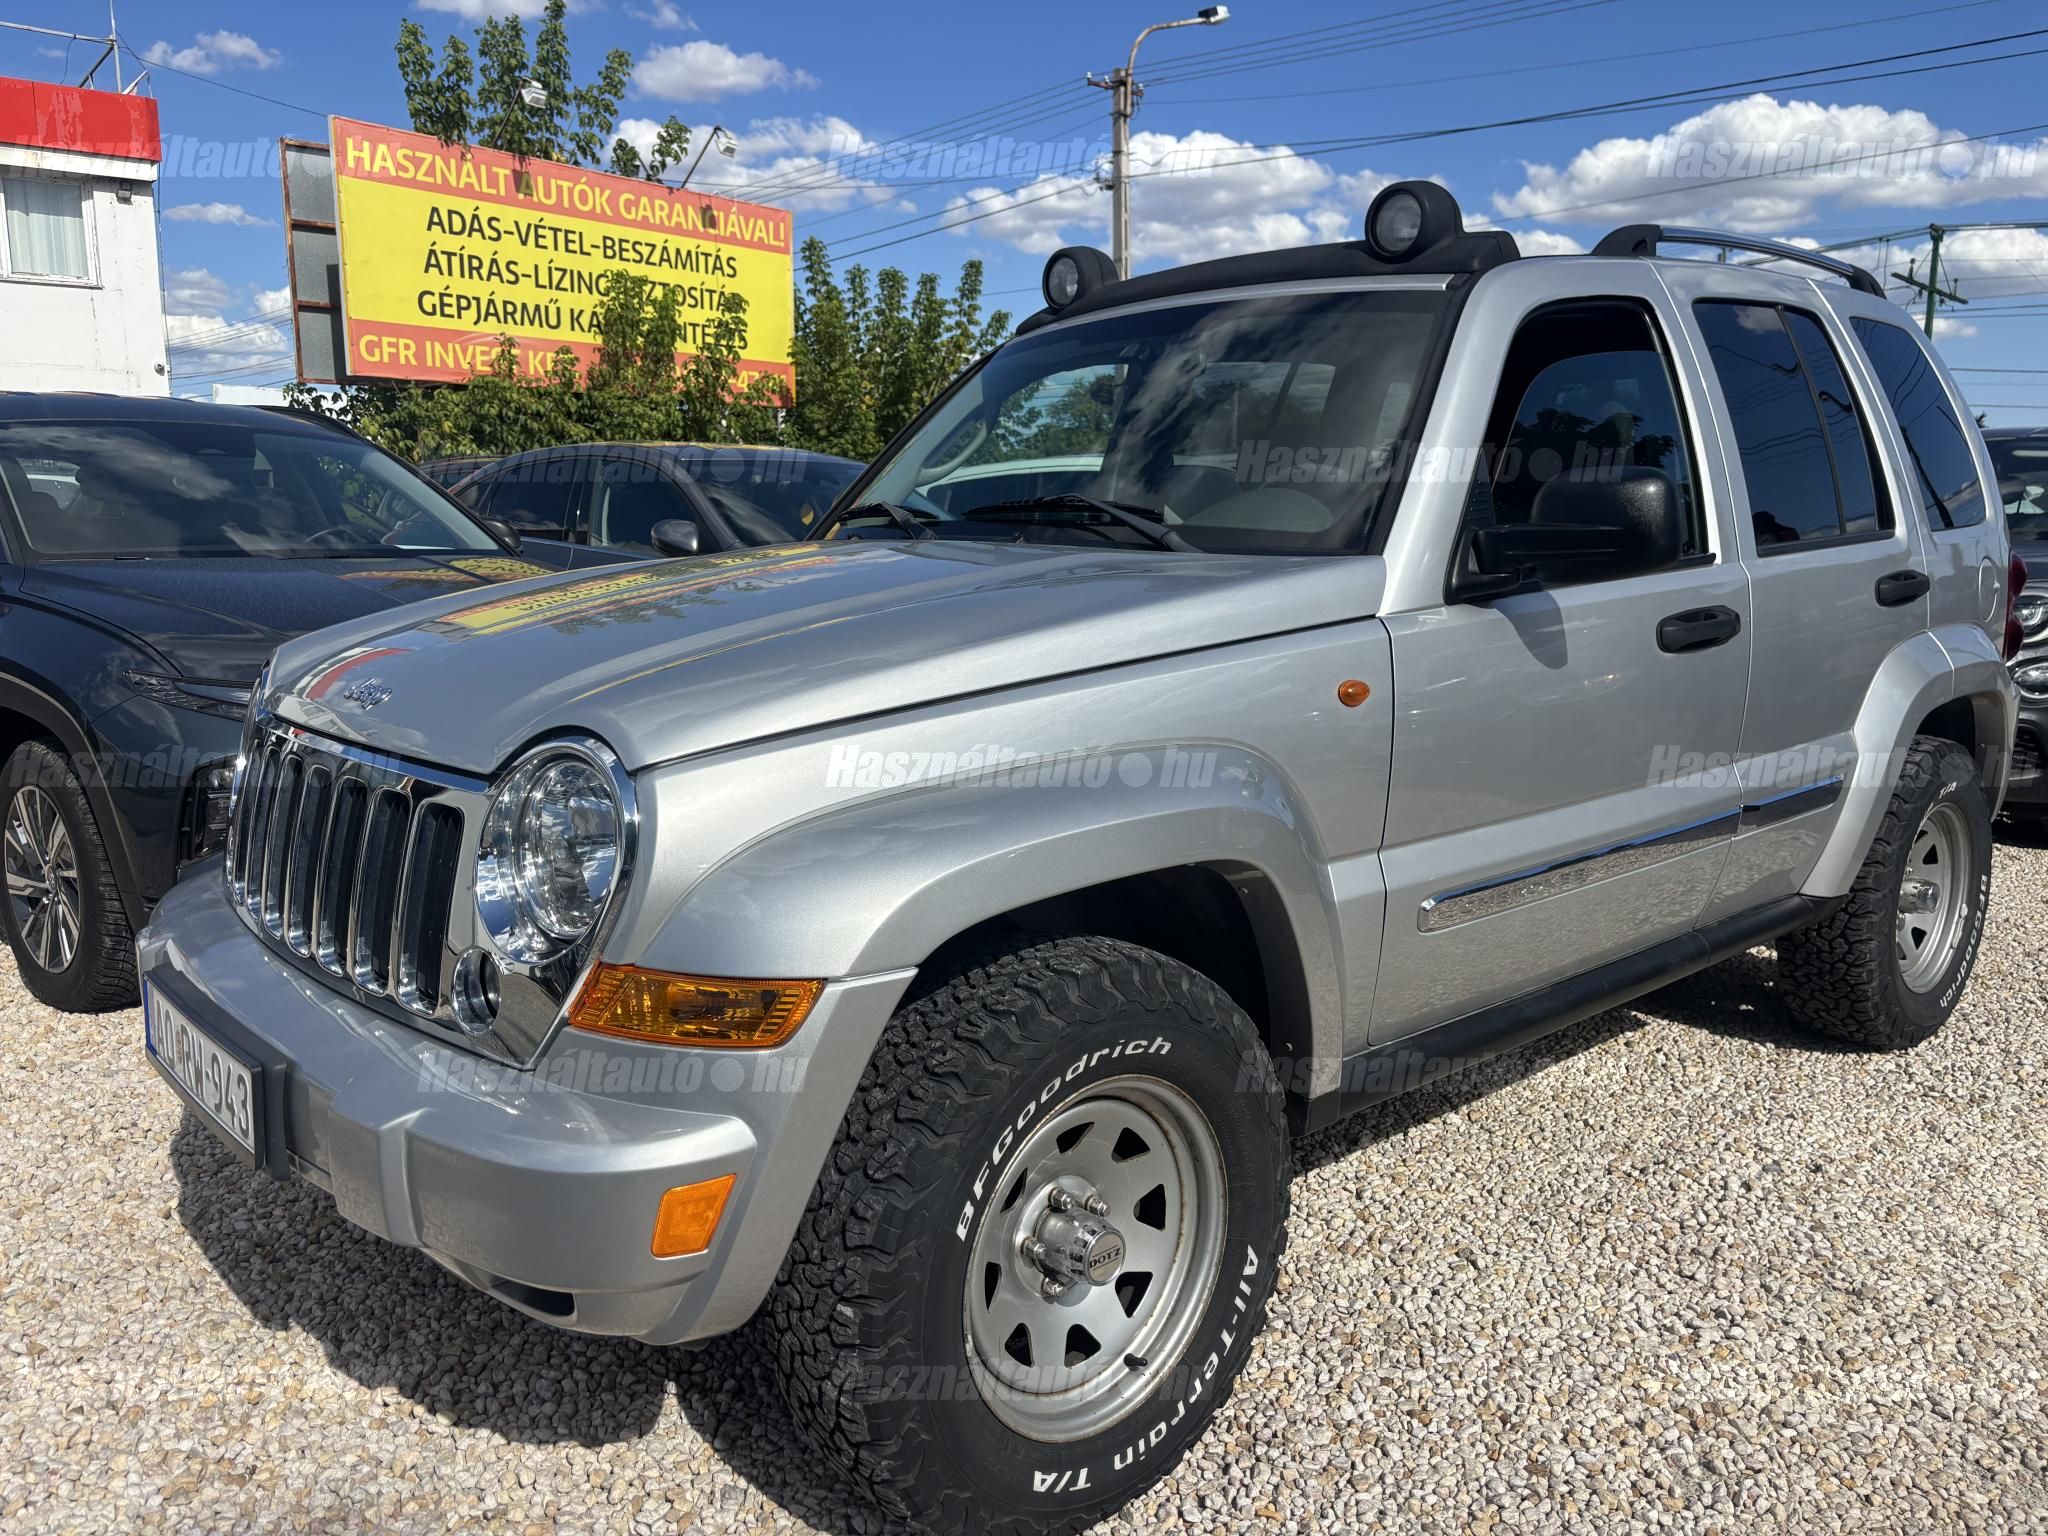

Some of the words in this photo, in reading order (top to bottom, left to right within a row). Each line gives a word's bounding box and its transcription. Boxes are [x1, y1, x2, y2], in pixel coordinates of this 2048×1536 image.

[345, 136, 510, 197] HASZNÁLT
[518, 176, 613, 216] AUTÓK
[619, 192, 785, 248] GARANCIÁVAL!
[417, 285, 562, 330] GÉPJÁRMŰ
[359, 335, 418, 366] GFR
[344, 679, 392, 710] Jeep
[1940, 874, 1988, 1008] BFGoodrich
[956, 1036, 1172, 1242] BFGoodrich
[1089, 1247, 1121, 1269] DOTZ
[1113, 1244, 1259, 1471] All-Terrain
[1033, 1467, 1092, 1494] T/A
